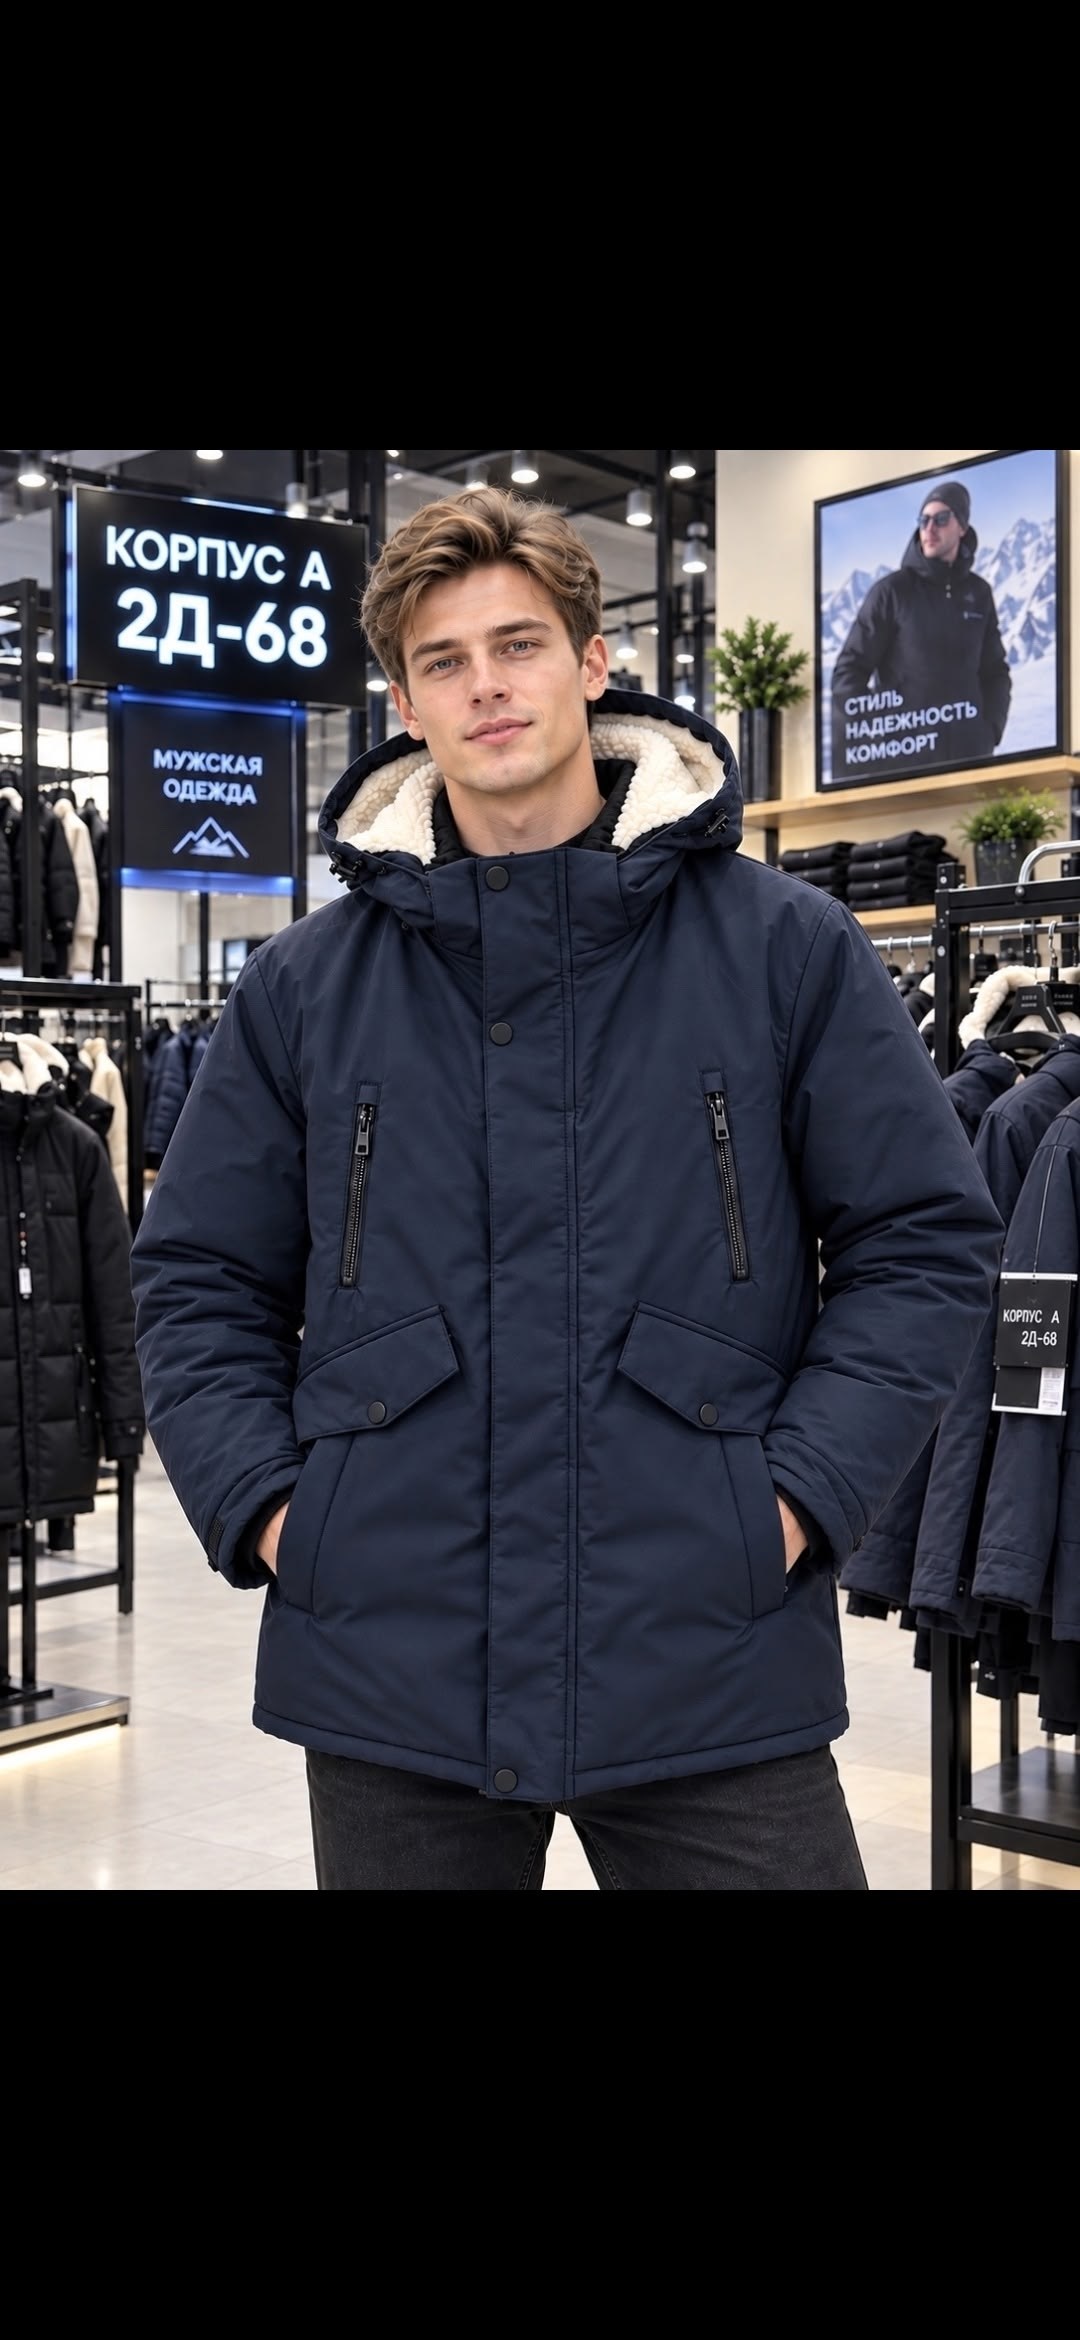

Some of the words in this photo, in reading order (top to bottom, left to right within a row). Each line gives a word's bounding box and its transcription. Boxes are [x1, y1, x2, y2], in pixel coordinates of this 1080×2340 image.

[106, 524, 286, 585] КОРПУС
[300, 550, 332, 591] А
[117, 587, 328, 669] 2Д-68
[845, 690, 904, 715] СТИЛЬ
[845, 701, 978, 739] НАДЕЖНОСТЬ
[153, 748, 263, 777] МУЖСКАЯ
[845, 733, 939, 764] КОМФОРТ
[162, 778, 258, 806] ОДЕЖДА
[1003, 1309, 1042, 1323] КОРПУС
[1051, 1310, 1060, 1324] А
[1021, 1331, 1057, 1348] 2Д-68
